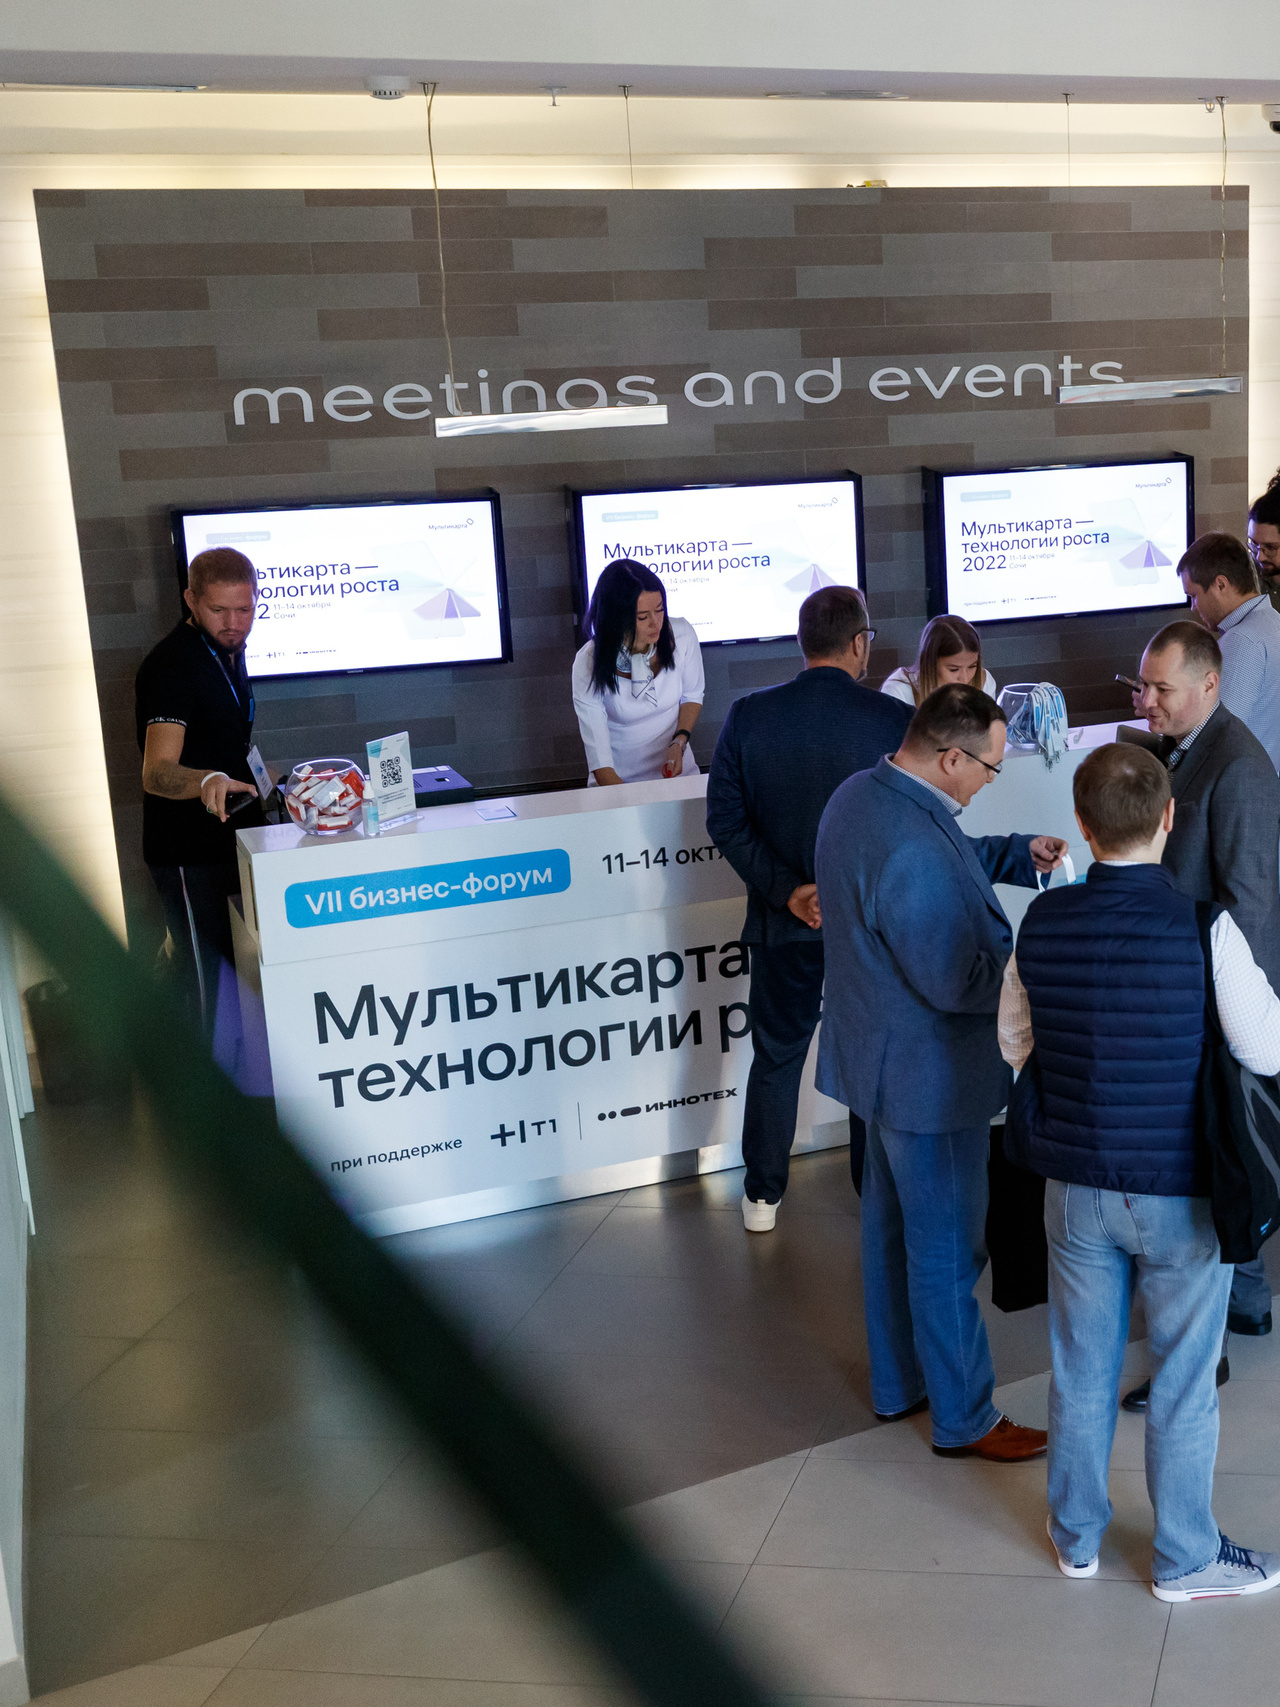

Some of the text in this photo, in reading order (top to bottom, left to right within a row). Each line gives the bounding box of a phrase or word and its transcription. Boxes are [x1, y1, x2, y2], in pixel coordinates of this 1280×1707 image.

[684, 357, 842, 408] and
[868, 355, 1125, 402] events
[961, 518, 1072, 538] Мультикарта
[603, 539, 729, 560] Мультикарта
[961, 531, 1110, 554] технологии роста
[256, 562, 351, 581] ьтикарта
[649, 554, 771, 575] ологии роста
[962, 553, 1007, 572] 2022
[260, 578, 400, 600] ологии роста
[273, 612, 296, 620] Сочи
[601, 846, 670, 875] 11–14
[305, 865, 553, 916] VII бизнес-форум
[313, 939, 752, 1047] Мультикарта
[318, 1009, 703, 1109] технологии
[645, 1086, 739, 1114] ИННОТЕХ
[330, 1137, 464, 1173] при поддержке
